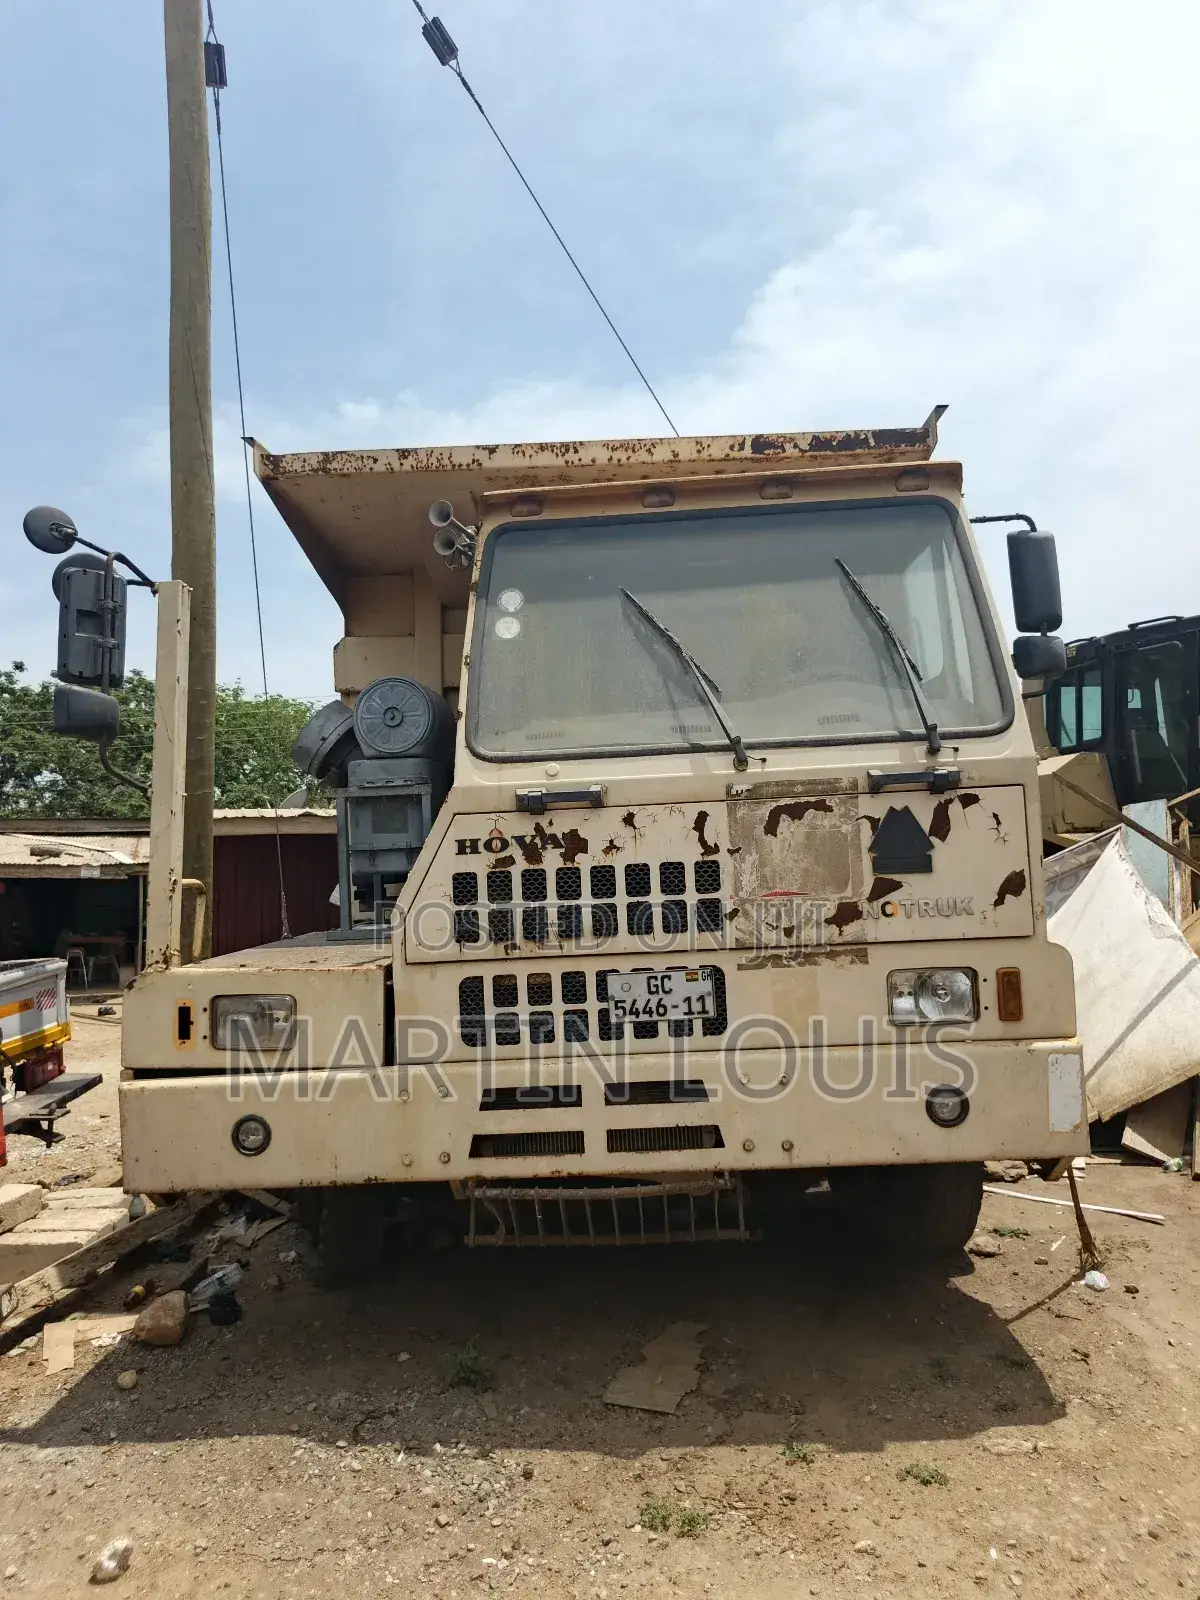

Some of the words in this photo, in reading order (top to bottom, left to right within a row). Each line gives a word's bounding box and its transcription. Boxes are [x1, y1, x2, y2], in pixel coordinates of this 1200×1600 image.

[455, 833, 565, 855] HOVA
[646, 975, 673, 995] GC
[701, 970, 711, 981] GH
[614, 995, 709, 1020] 5446-11
